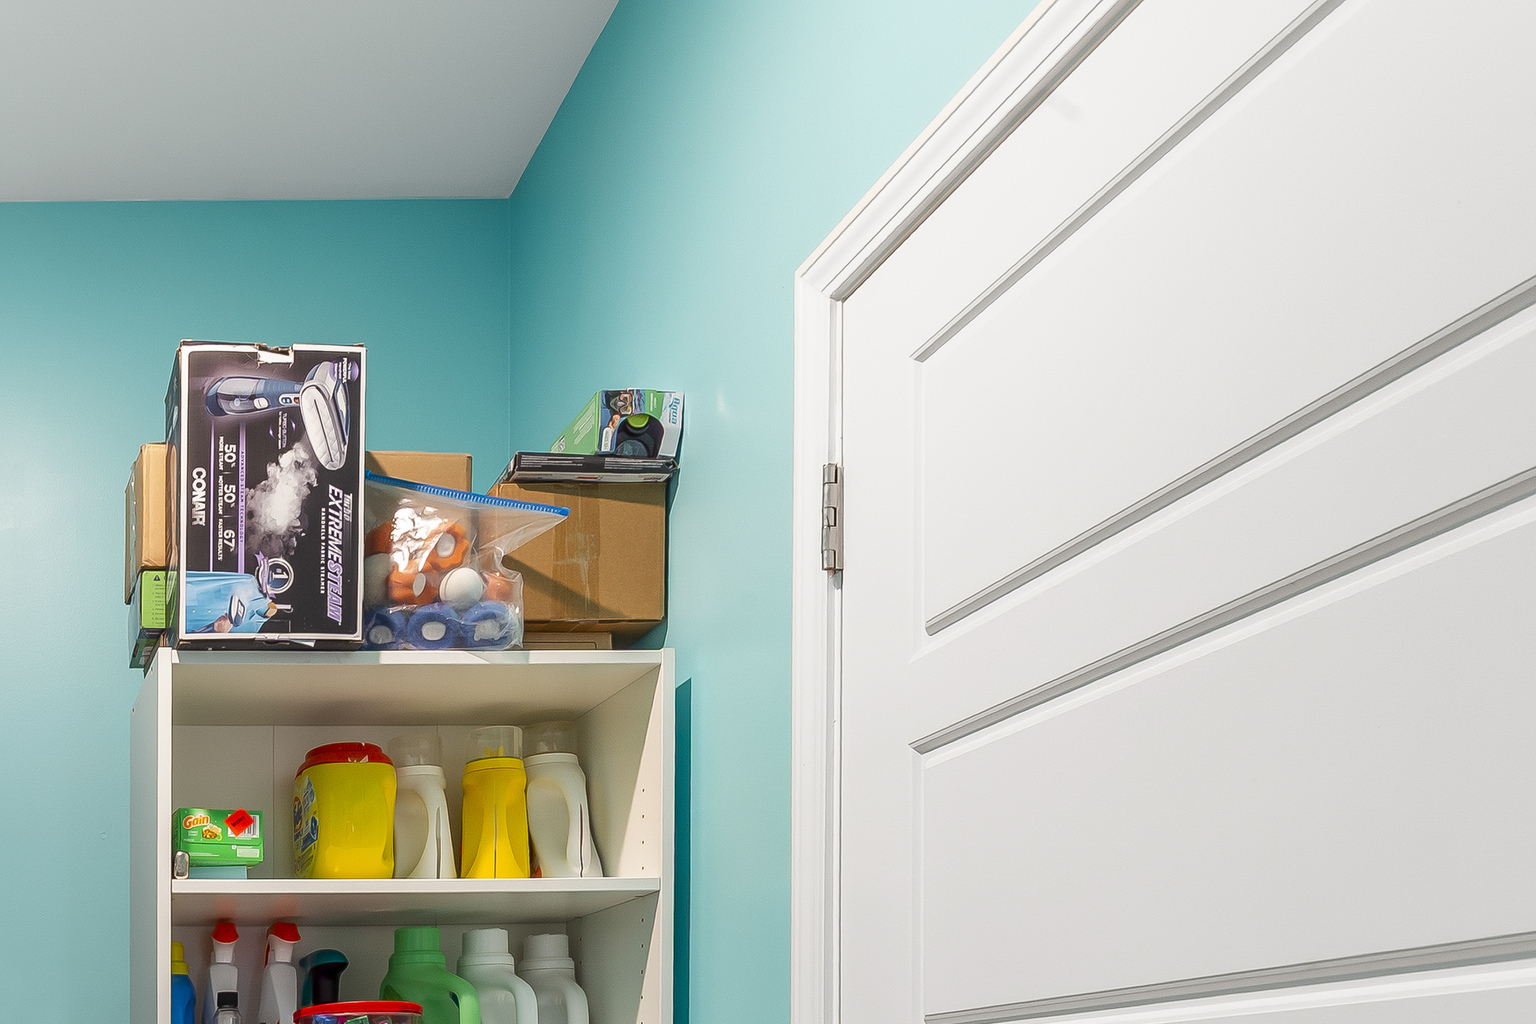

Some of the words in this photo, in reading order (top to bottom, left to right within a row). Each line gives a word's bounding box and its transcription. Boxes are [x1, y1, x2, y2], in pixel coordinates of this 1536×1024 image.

[669, 397, 680, 425] Aqua
[192, 467, 206, 526] CONAIR
[343, 492, 352, 522] Turbo
[183, 814, 210, 829] Gain
